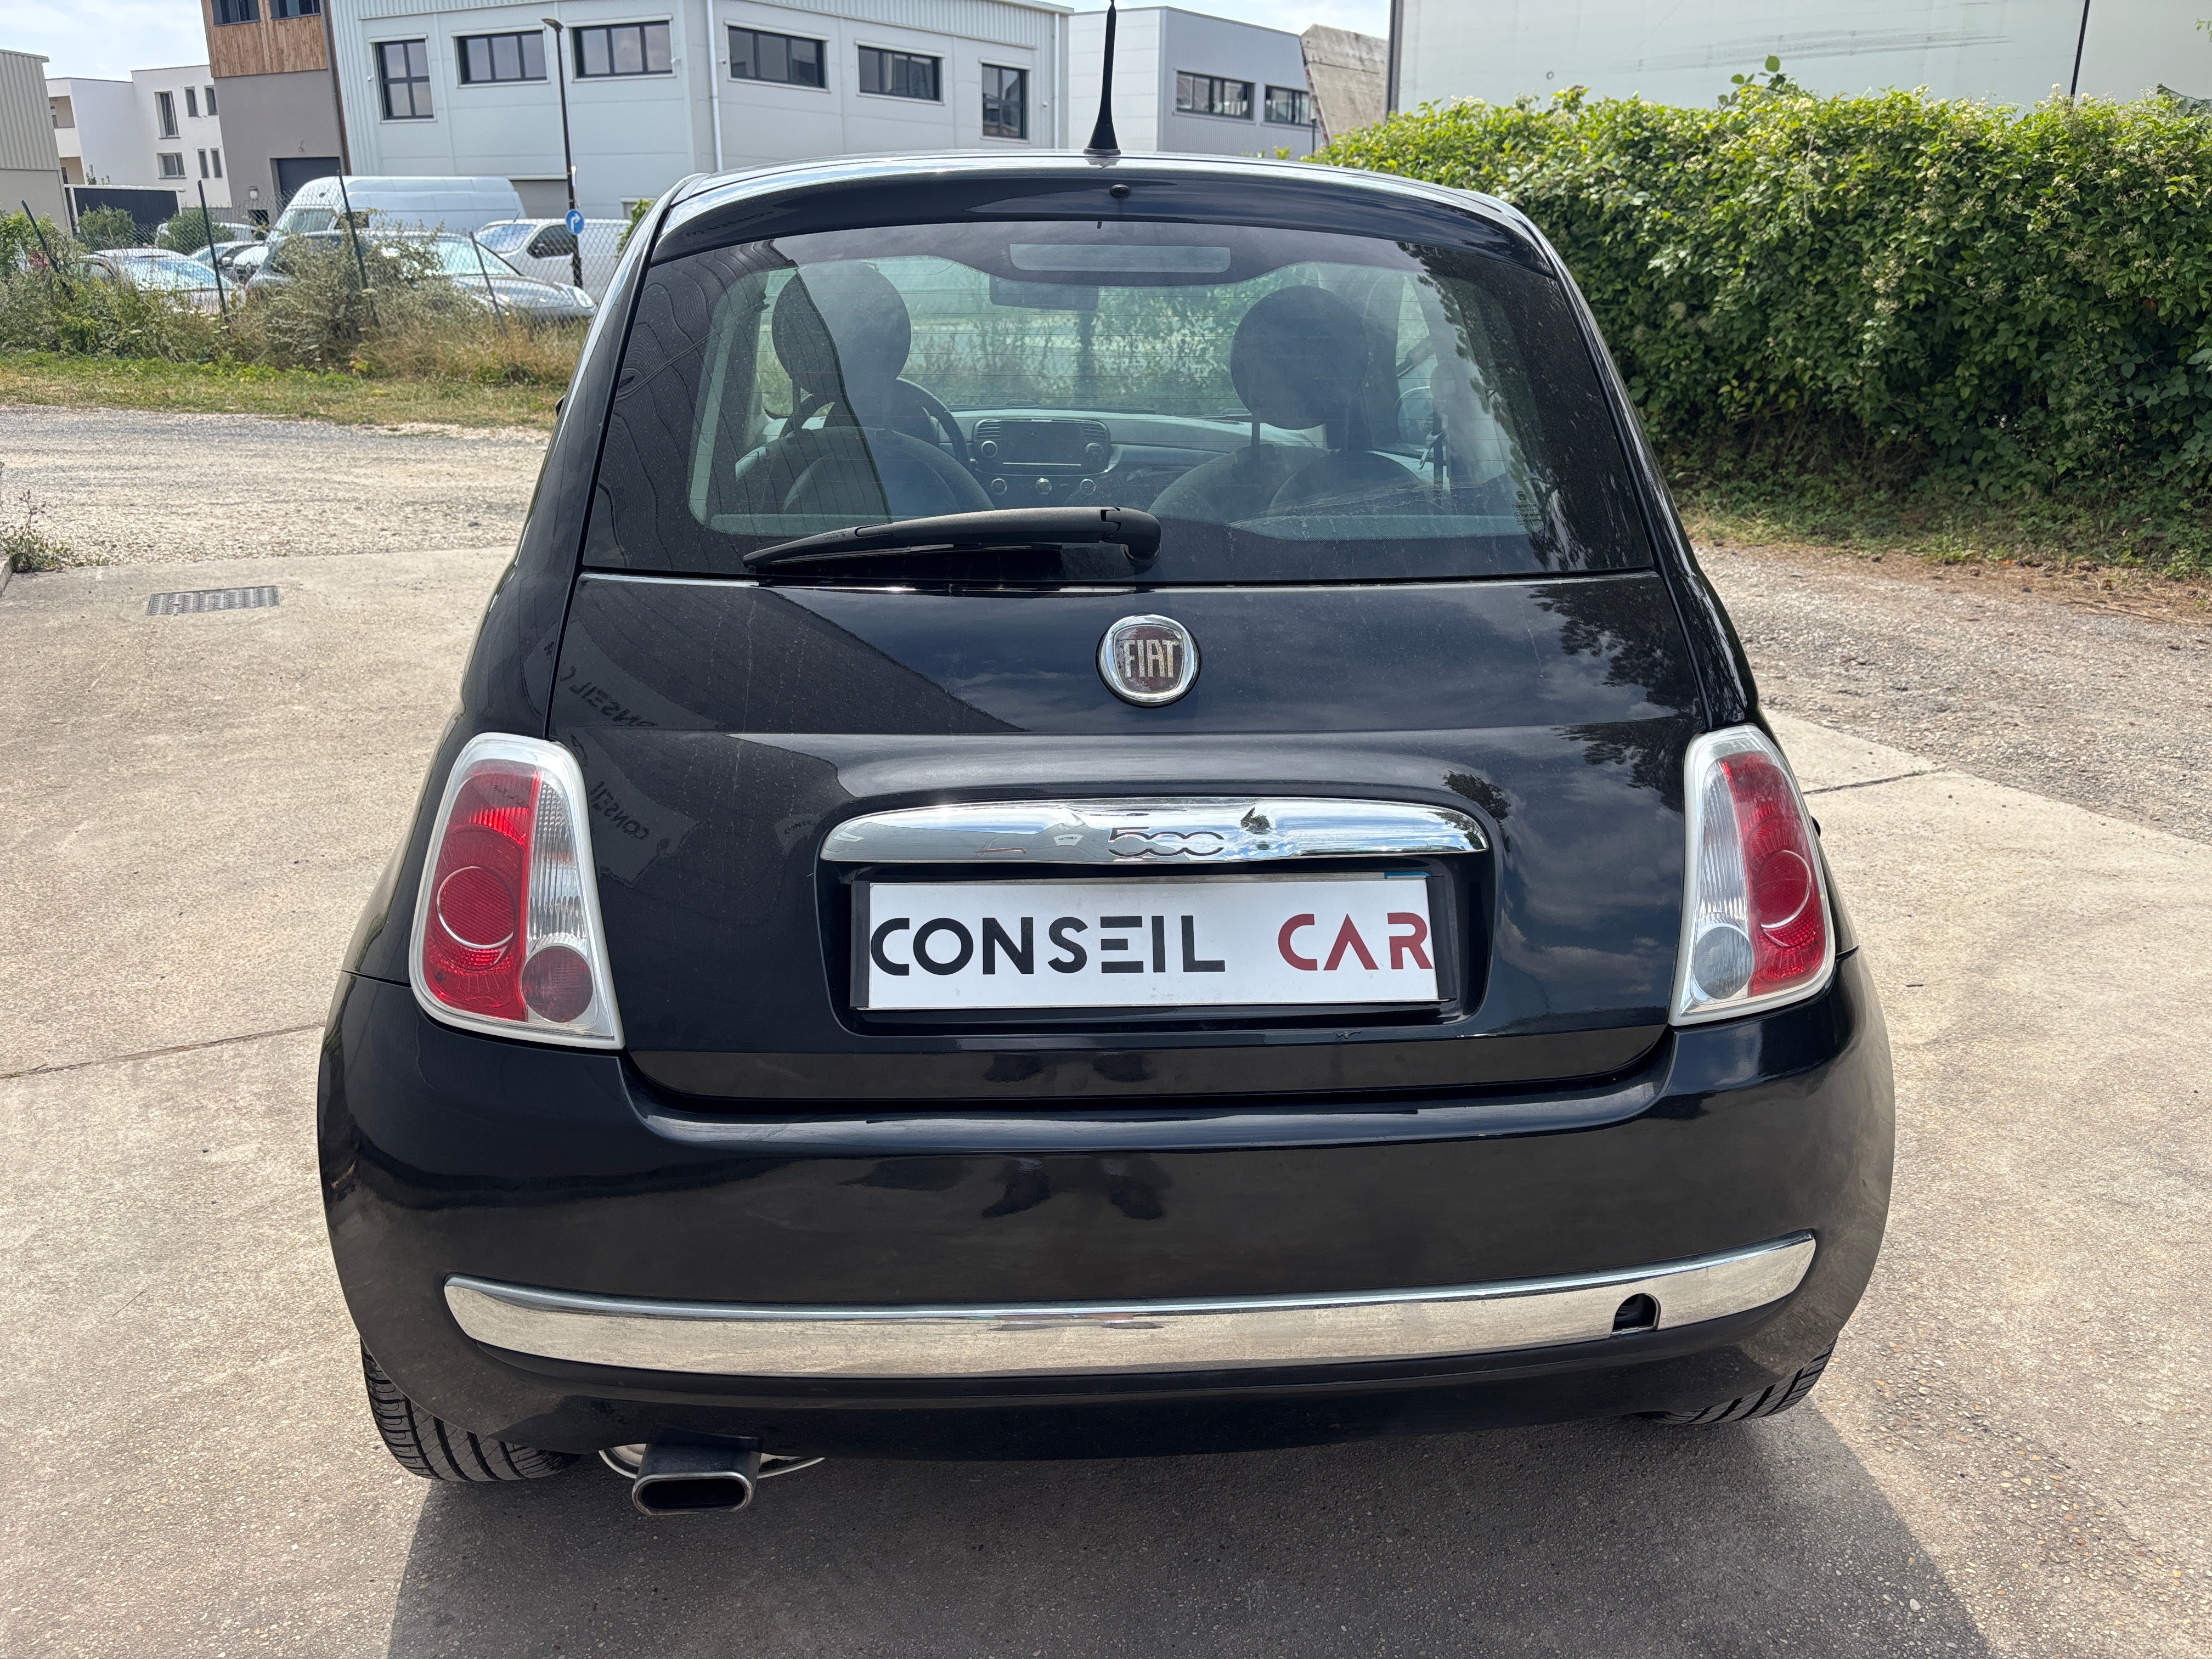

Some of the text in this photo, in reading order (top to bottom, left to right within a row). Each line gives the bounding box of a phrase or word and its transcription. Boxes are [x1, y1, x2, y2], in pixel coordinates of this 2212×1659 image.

[1122, 639, 1180, 679] FIAT
[1108, 826, 1224, 857] 500
[870, 912, 1434, 977] CONSEIL CAR
